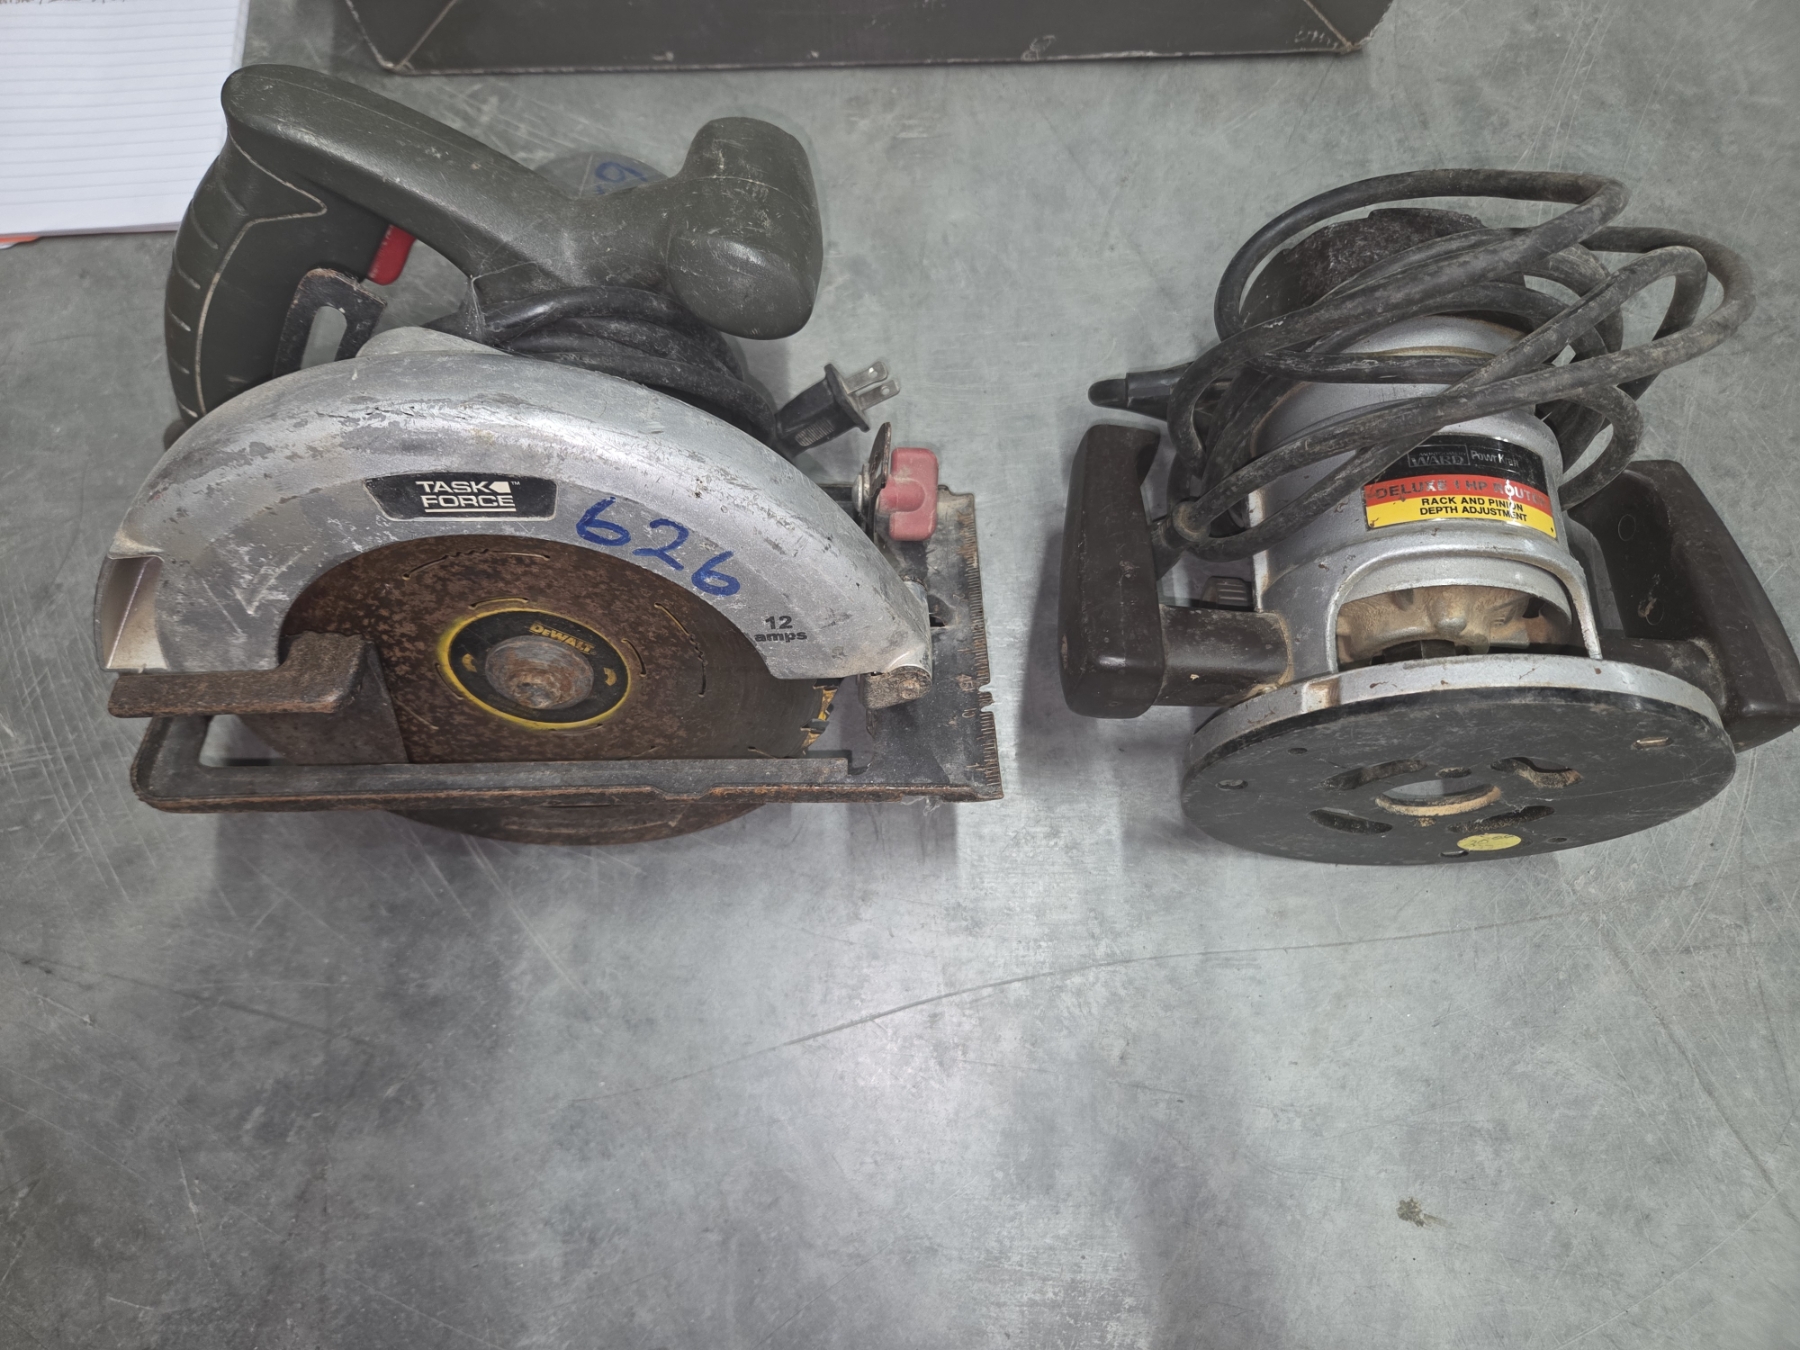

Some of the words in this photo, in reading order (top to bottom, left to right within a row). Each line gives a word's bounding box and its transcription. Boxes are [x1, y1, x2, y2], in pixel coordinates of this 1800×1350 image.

[415, 480, 490, 493] TASK
[1376, 480, 1449, 499] DELUXE
[1466, 480, 1488, 491] HP
[420, 494, 516, 507] FORCE
[1421, 496, 1457, 506] RACK
[1460, 496, 1485, 506] AND
[1488, 499, 1524, 512] PINION
[1419, 506, 1459, 516] DEPTH
[1461, 506, 1528, 522] ADJUSTMENT
[576, 496, 740, 597] 626
[765, 615, 793, 629] 12
[528, 621, 596, 655] DeWALT
[755, 629, 808, 643] amps
